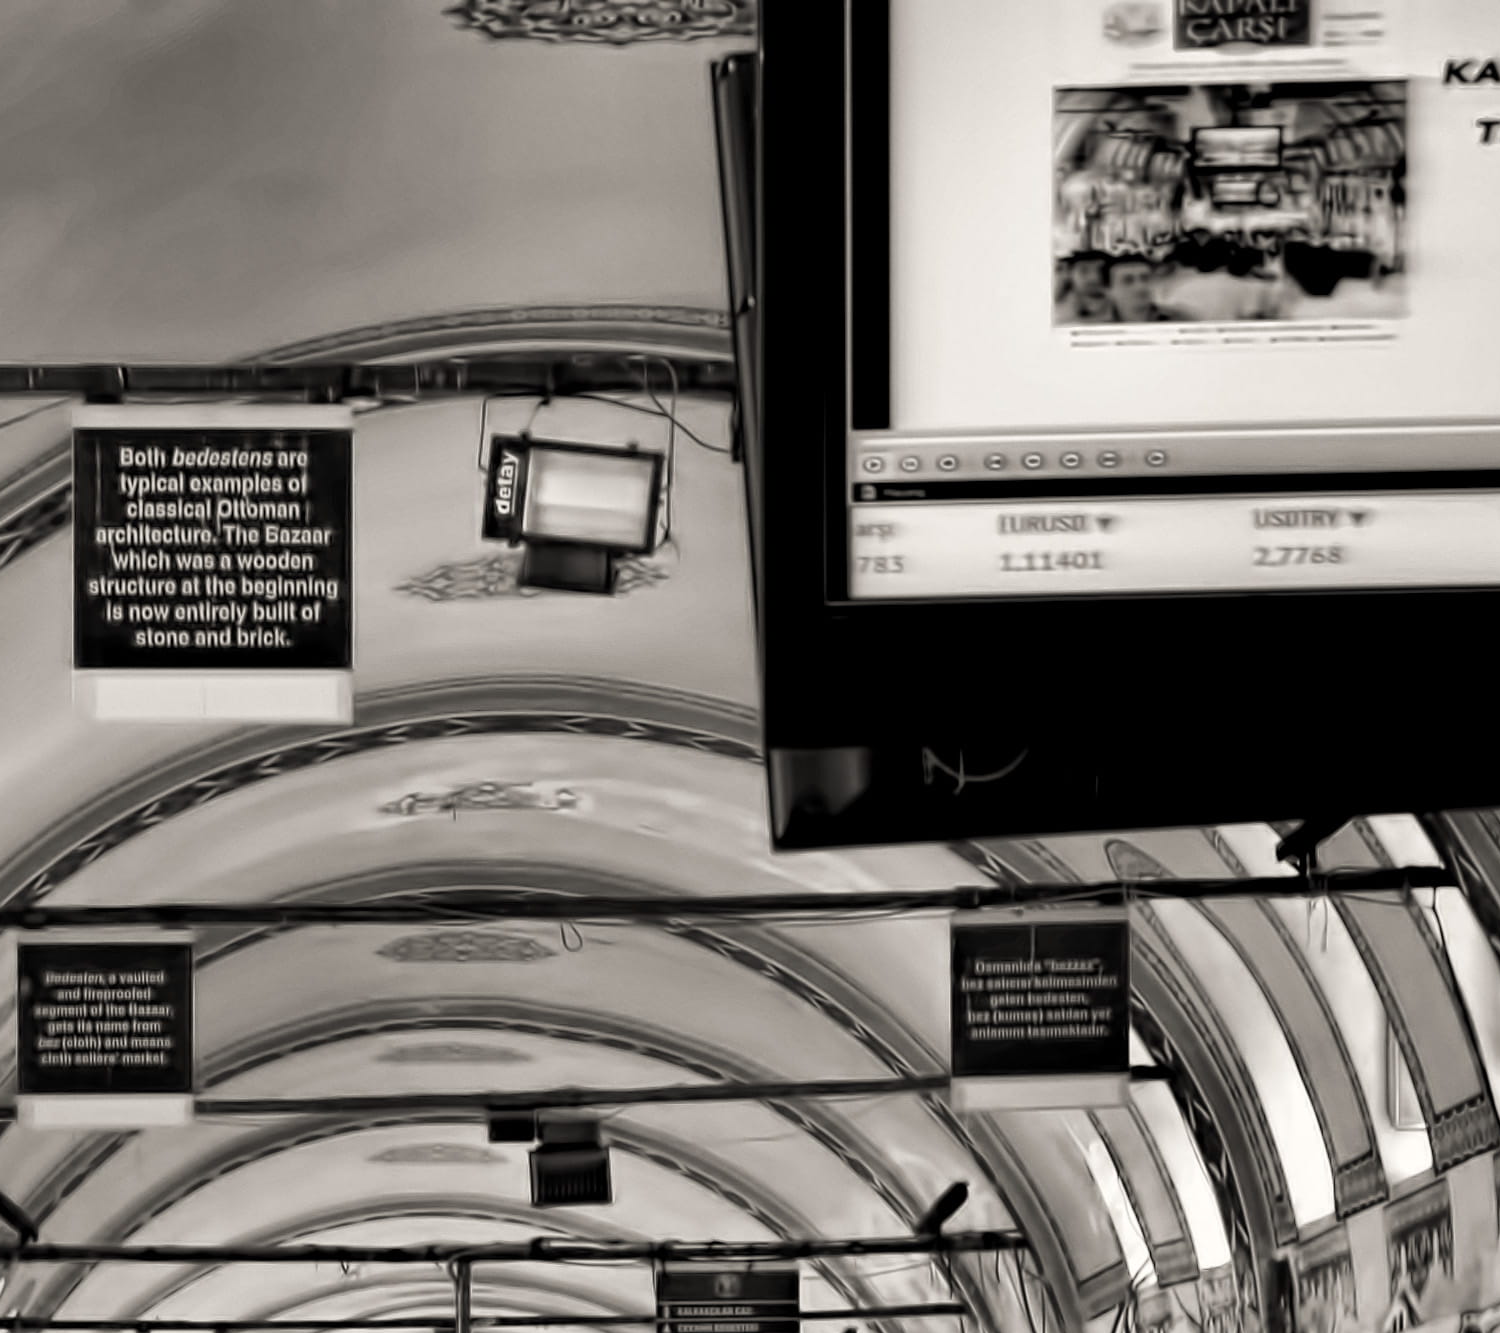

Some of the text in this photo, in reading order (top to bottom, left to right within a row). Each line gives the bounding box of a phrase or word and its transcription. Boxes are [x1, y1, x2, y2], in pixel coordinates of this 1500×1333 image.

[120, 447, 308, 467] Both bedestens are
[120, 473, 307, 496] typical examples of
[127, 500, 300, 518] classical Ottoman
[96, 525, 331, 545] architecture. The Bazaar
[112, 550, 314, 570] which was a wooden
[89, 576, 338, 599] structure at the beginning
[106, 602, 321, 625] is now entirely built of
[136, 628, 291, 647] stone and brick.
